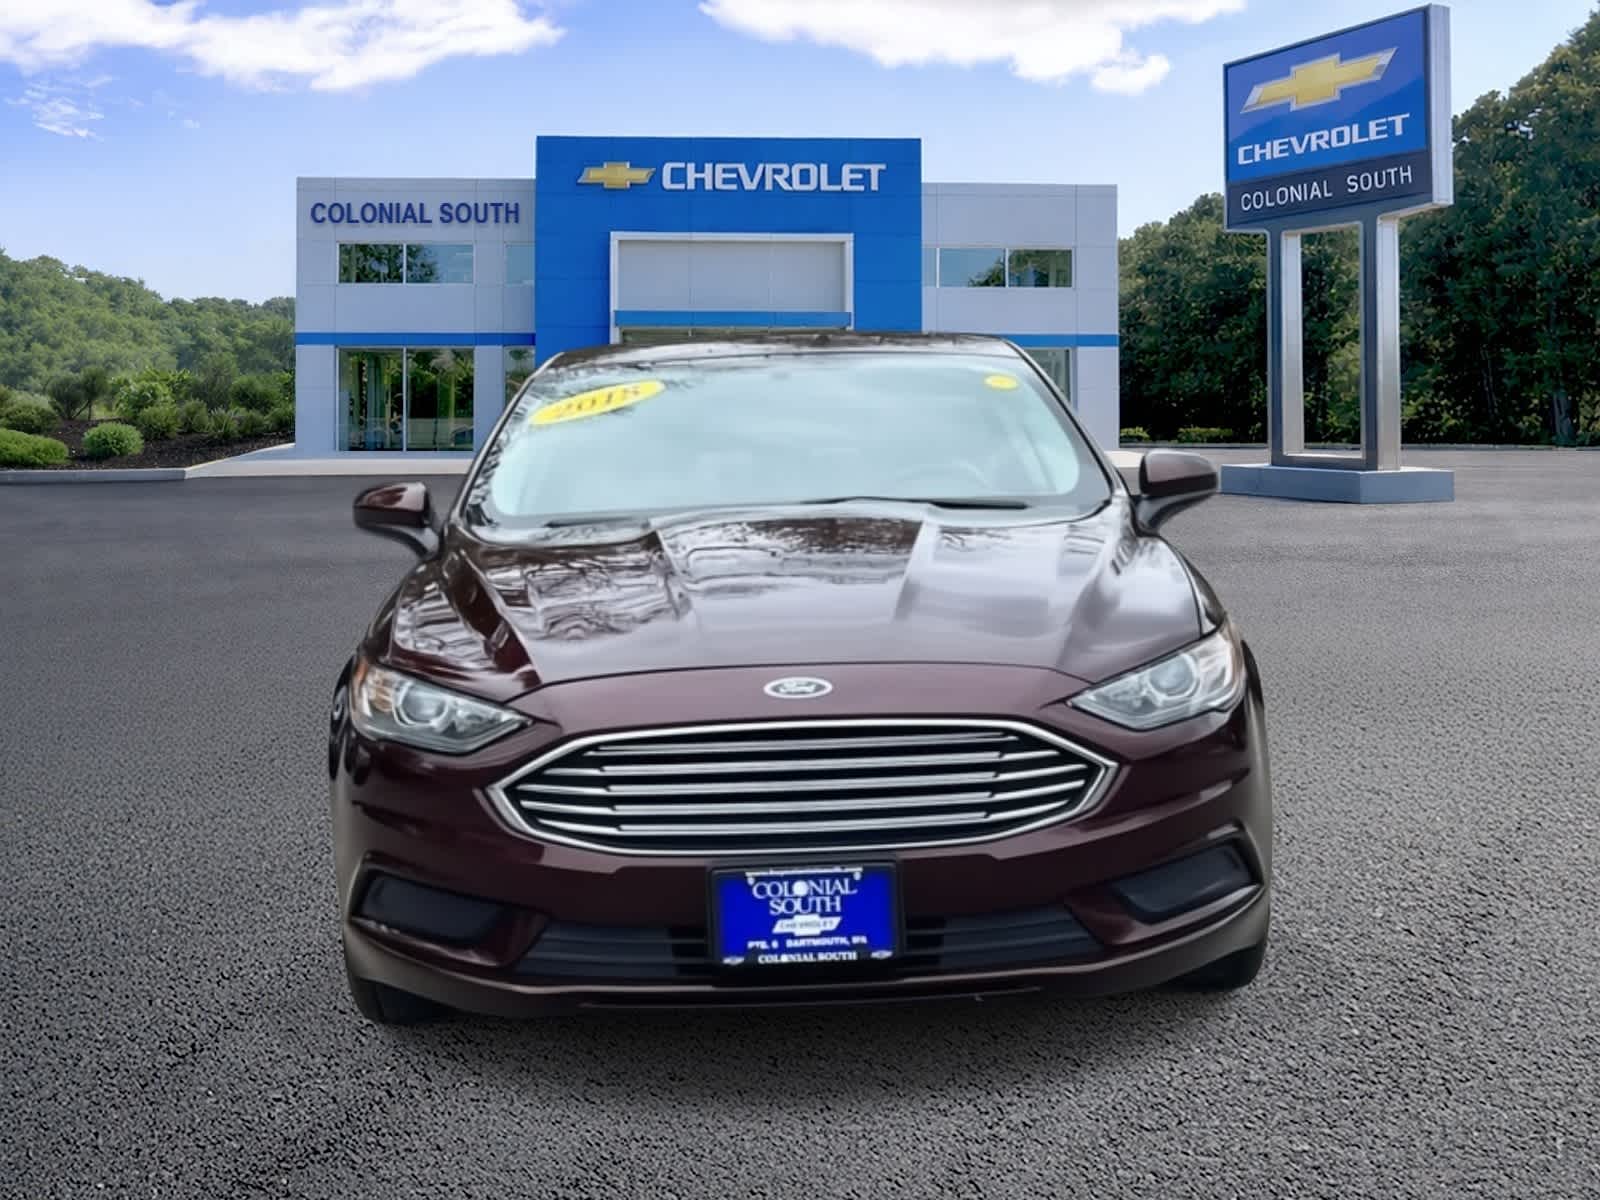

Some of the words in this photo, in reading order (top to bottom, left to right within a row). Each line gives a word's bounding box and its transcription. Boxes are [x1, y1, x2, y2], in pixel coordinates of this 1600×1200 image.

[1238, 113, 1411, 165] CHEVROLET
[662, 162, 887, 191] CHEVROLET
[1240, 180, 1333, 211] COLONIAL
[1346, 165, 1413, 193] SOUTH
[310, 202, 433, 224] COLONIAL
[439, 202, 520, 224] SOUTH
[752, 877, 858, 899] COLONIAL
[769, 895, 842, 916] SOUTH
[758, 952, 816, 964] COLONIAL
[817, 951, 858, 961] SOUTH
